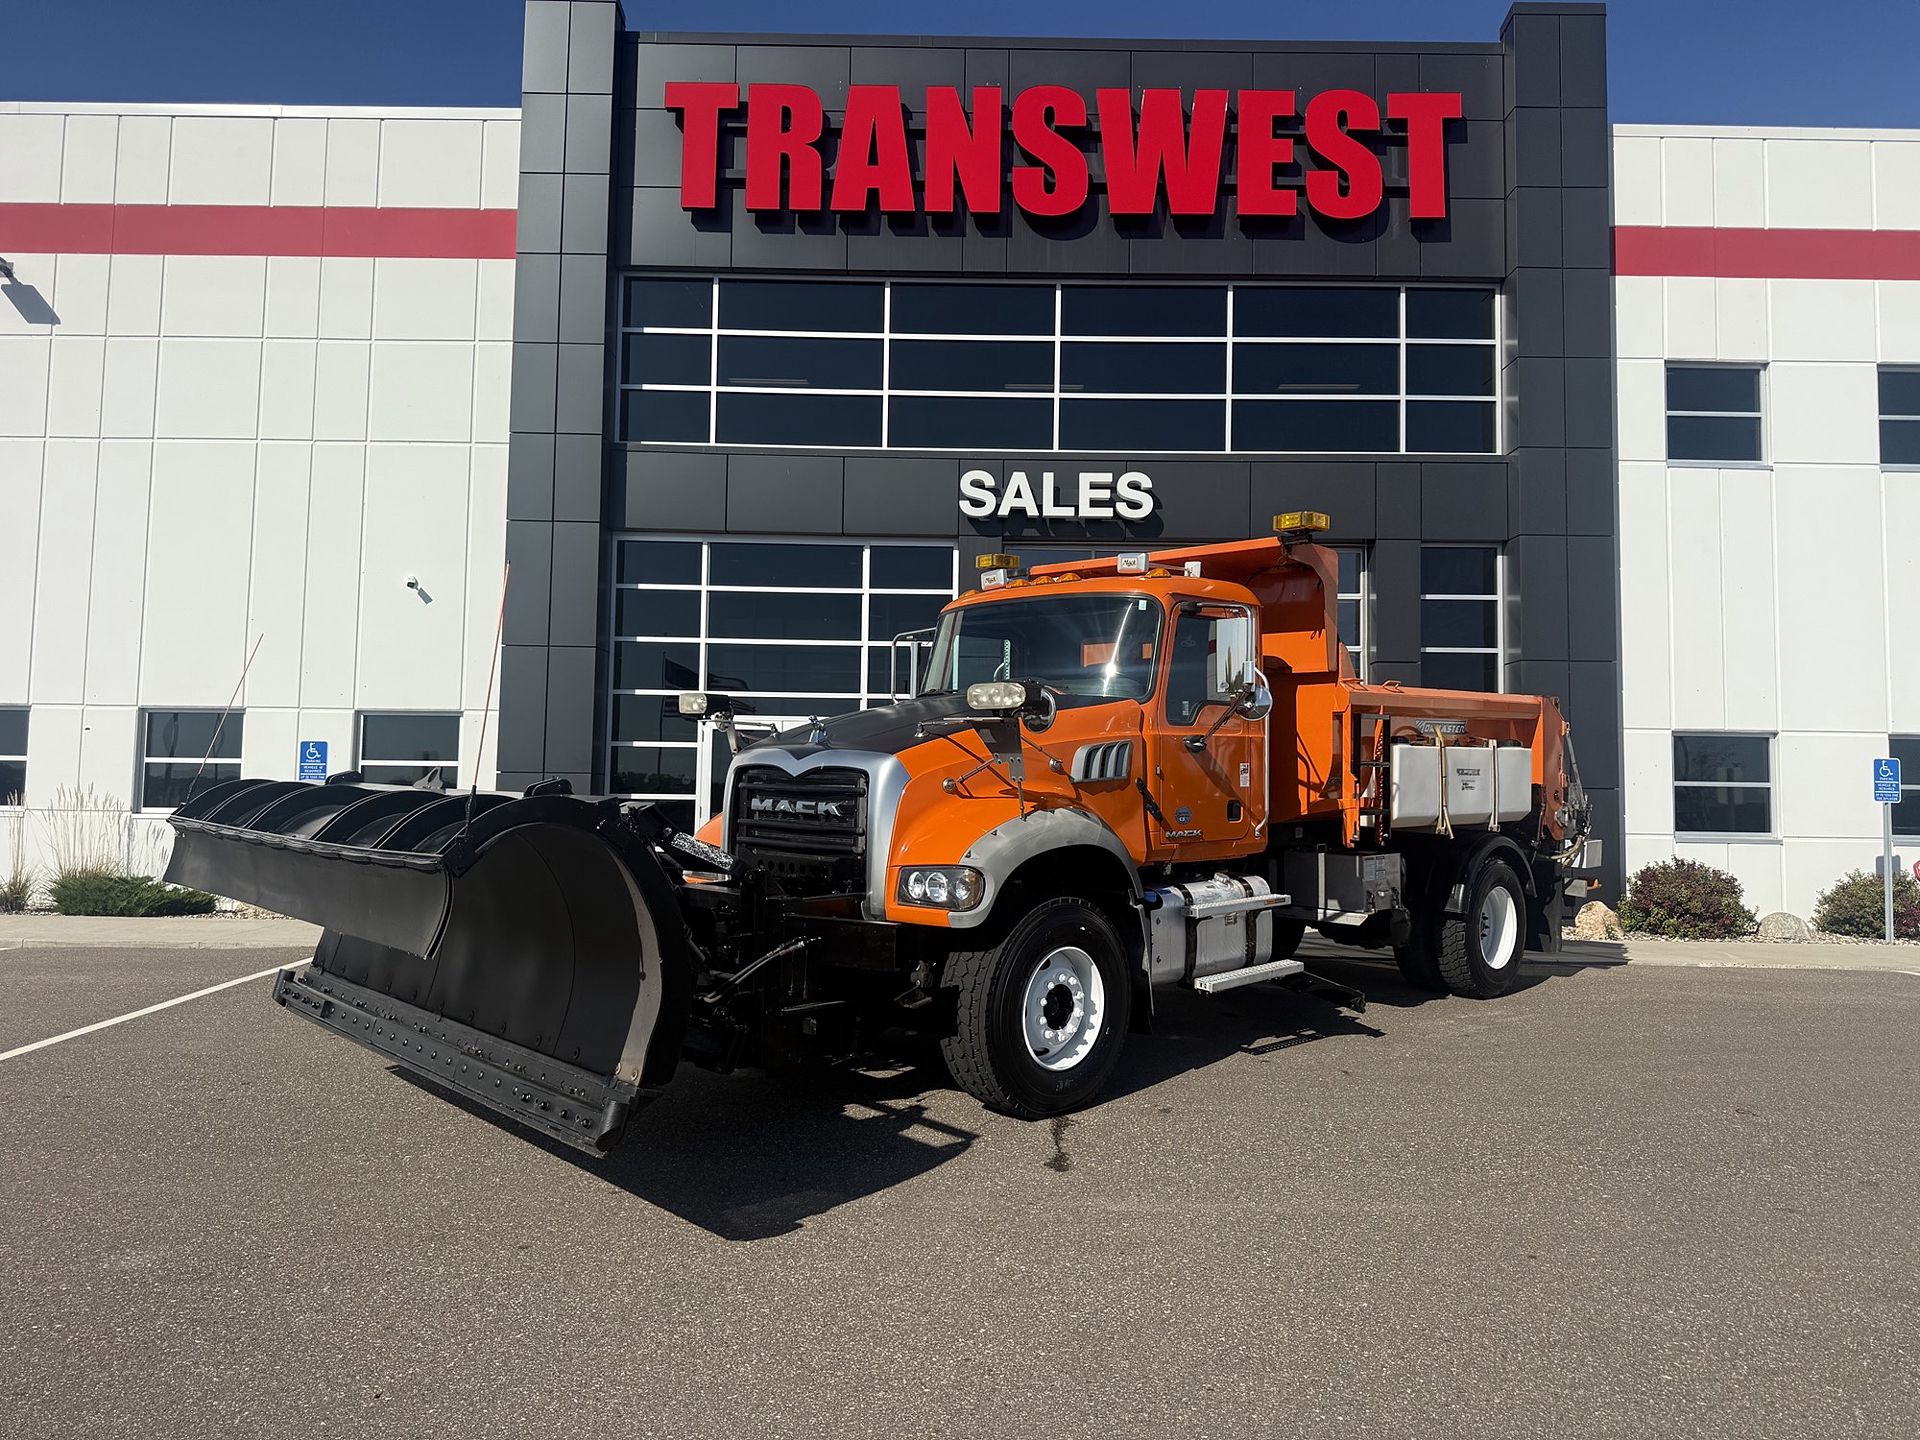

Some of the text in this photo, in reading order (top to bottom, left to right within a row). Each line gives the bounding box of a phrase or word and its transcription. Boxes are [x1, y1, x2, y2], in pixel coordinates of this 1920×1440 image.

[664, 82, 1463, 220] TRANSWEST
[959, 469, 1154, 521] SALES
[751, 798, 843, 817] MACK
[1165, 829, 1202, 838] MACK
